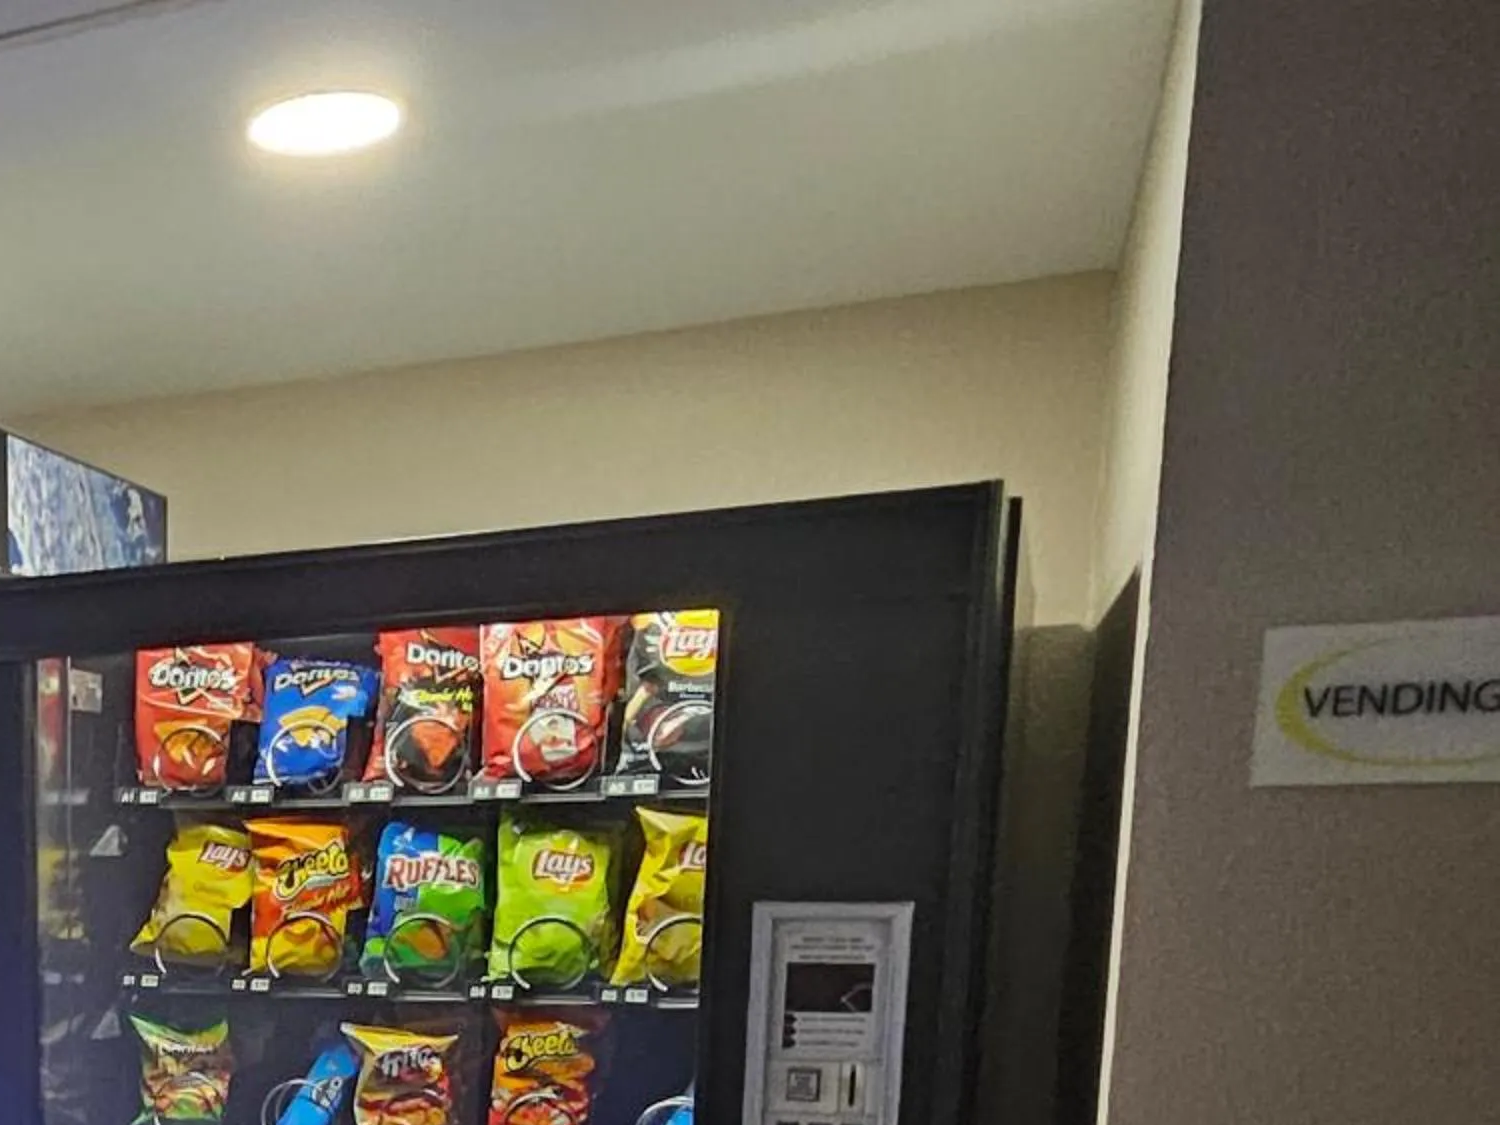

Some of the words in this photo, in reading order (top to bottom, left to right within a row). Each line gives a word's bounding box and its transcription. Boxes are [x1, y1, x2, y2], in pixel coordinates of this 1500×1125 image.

[407, 644, 480, 670] Dorito
[668, 628, 716, 658] Lay
[150, 662, 239, 690] Doritos
[273, 667, 359, 691] Doritos
[502, 653, 594, 679] Doritos
[1304, 678, 1500, 718] VENDING
[275, 843, 349, 897] Cheeto
[388, 855, 479, 887] RUFFLES
